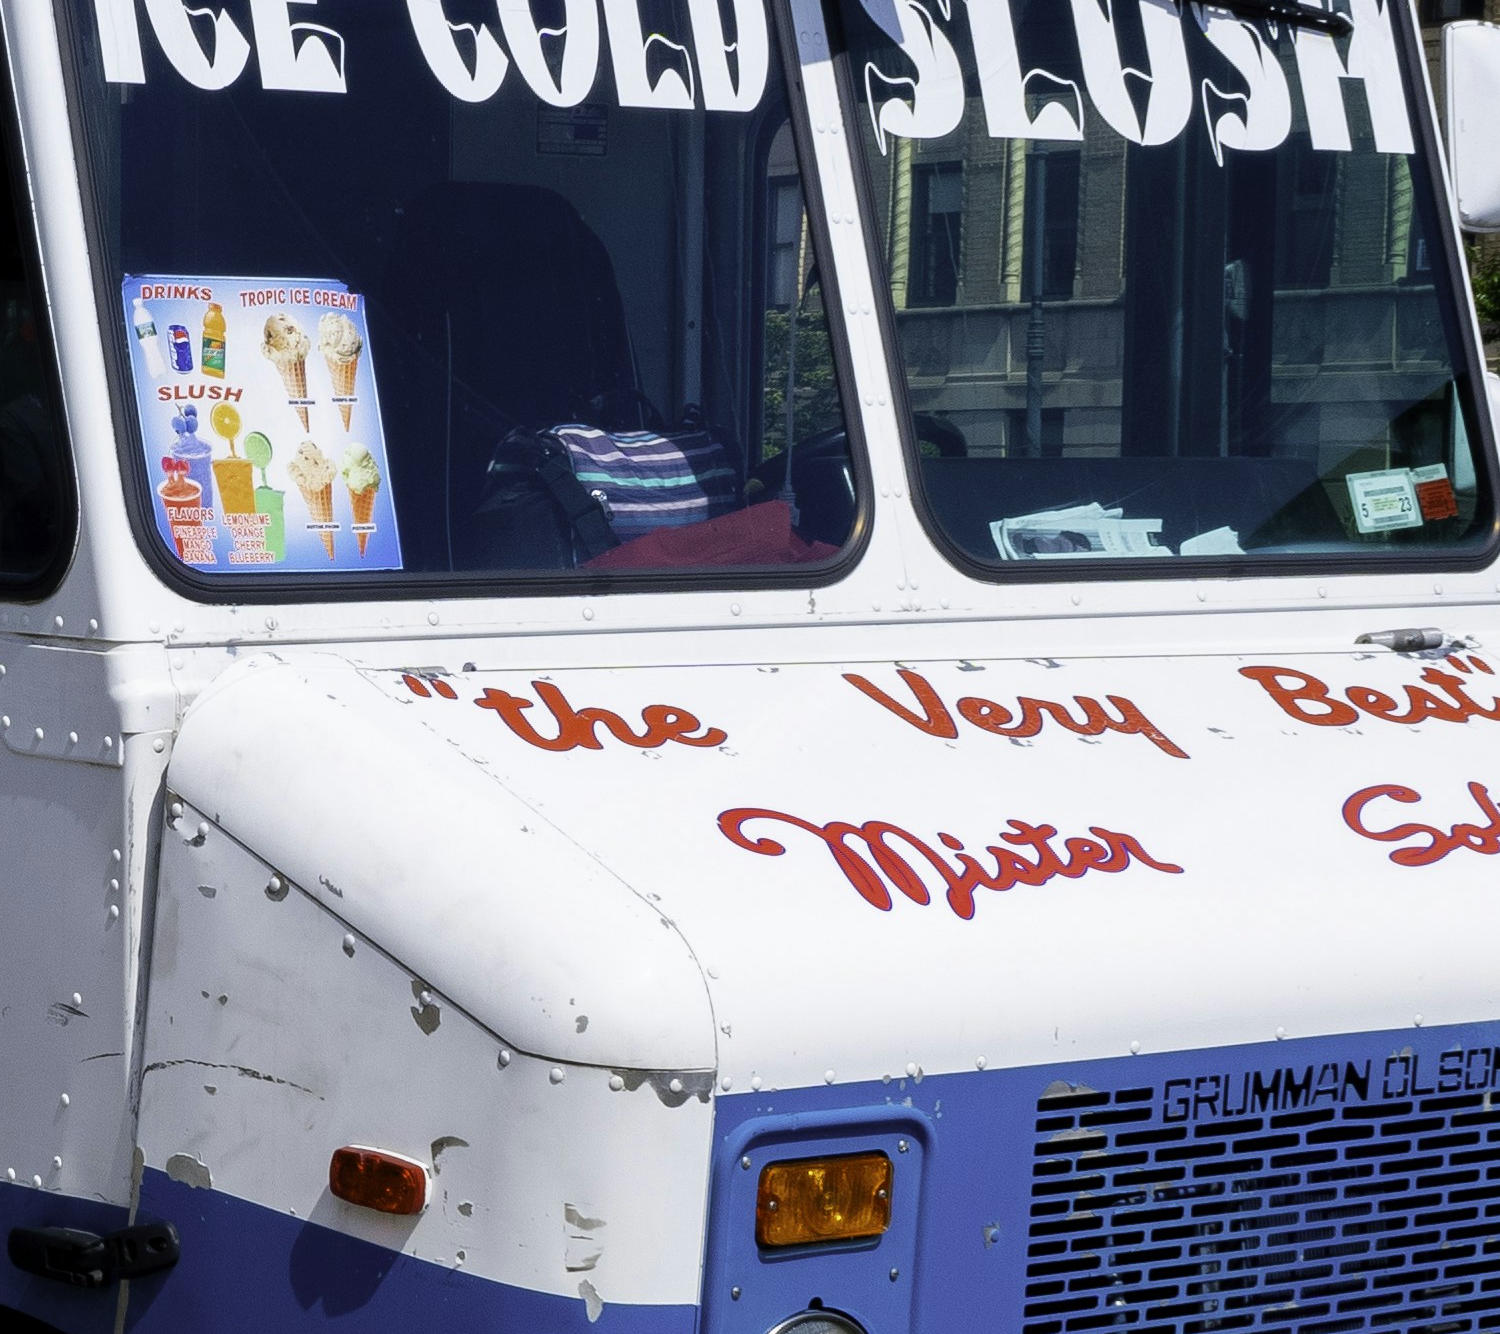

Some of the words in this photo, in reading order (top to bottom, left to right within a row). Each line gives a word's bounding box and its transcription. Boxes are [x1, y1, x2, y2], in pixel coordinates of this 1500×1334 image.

[140, 284, 213, 301] DRINKS
[239, 289, 286, 308] TROPIC
[290, 289, 311, 305] ICE
[313, 292, 358, 312] CREAM
[157, 384, 243, 402] SLUSH
[1361, 503, 1369, 518] 5
[1399, 496, 1413, 513] 23
[168, 508, 214, 521] FLAVORS
[221, 514, 271, 526] LEMON-LIME
[174, 527, 218, 539] PINEAPPLE
[230, 527, 265, 539] ORANGE
[183, 539, 213, 551] MANGO
[234, 539, 267, 551] CHERRY
[183, 551, 217, 564] BANANA
[229, 551, 276, 564] BLUEBERRY
[401, 672, 728, 753] "the
[841, 669, 1190, 759] Very
[716, 807, 1185, 921] Mister
[1162, 1058, 1372, 1124] GRUMMAN
